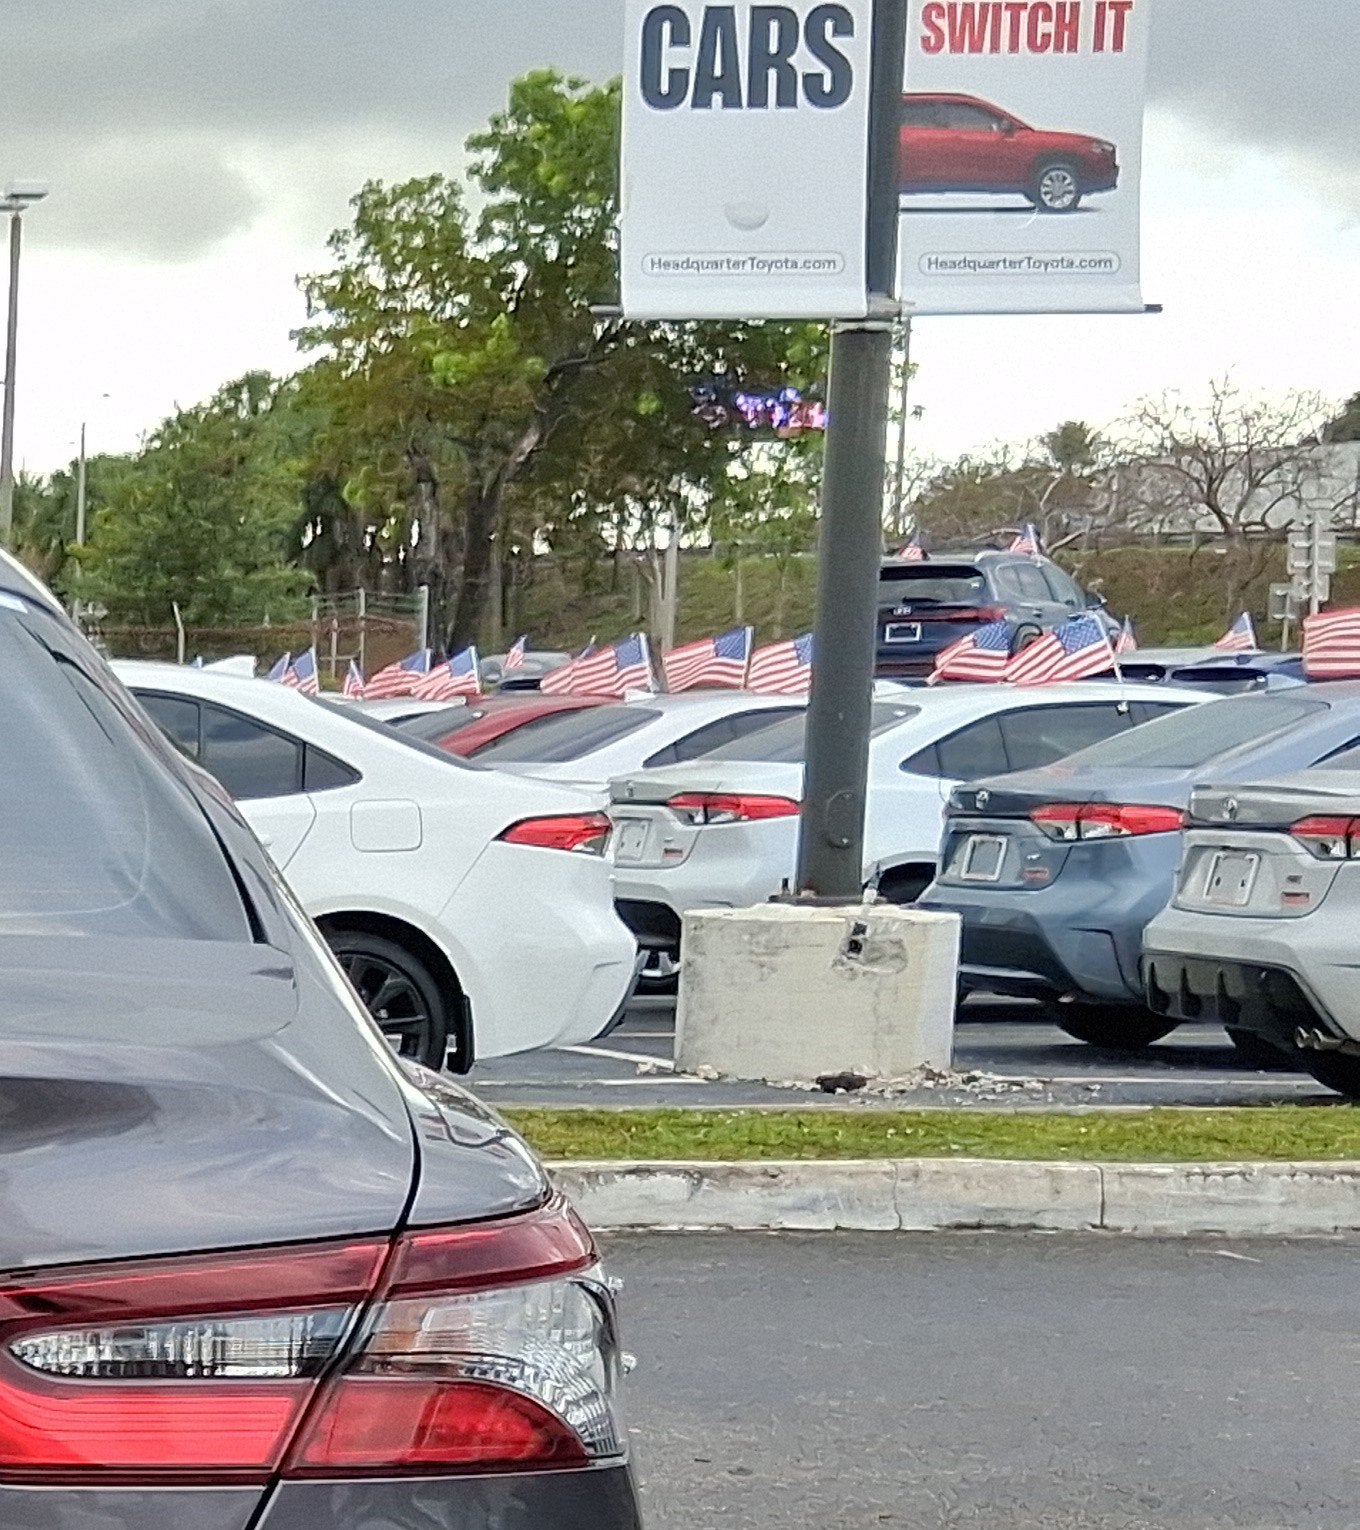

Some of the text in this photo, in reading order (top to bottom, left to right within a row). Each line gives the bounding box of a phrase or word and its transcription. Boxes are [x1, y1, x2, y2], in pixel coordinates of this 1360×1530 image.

[920, 1, 1133, 54] SWITCH IT
[640, 3, 855, 110] CARS
[650, 256, 837, 273] HeadquarterToyota.com
[926, 256, 1113, 272] HeadquarterToyota.com
